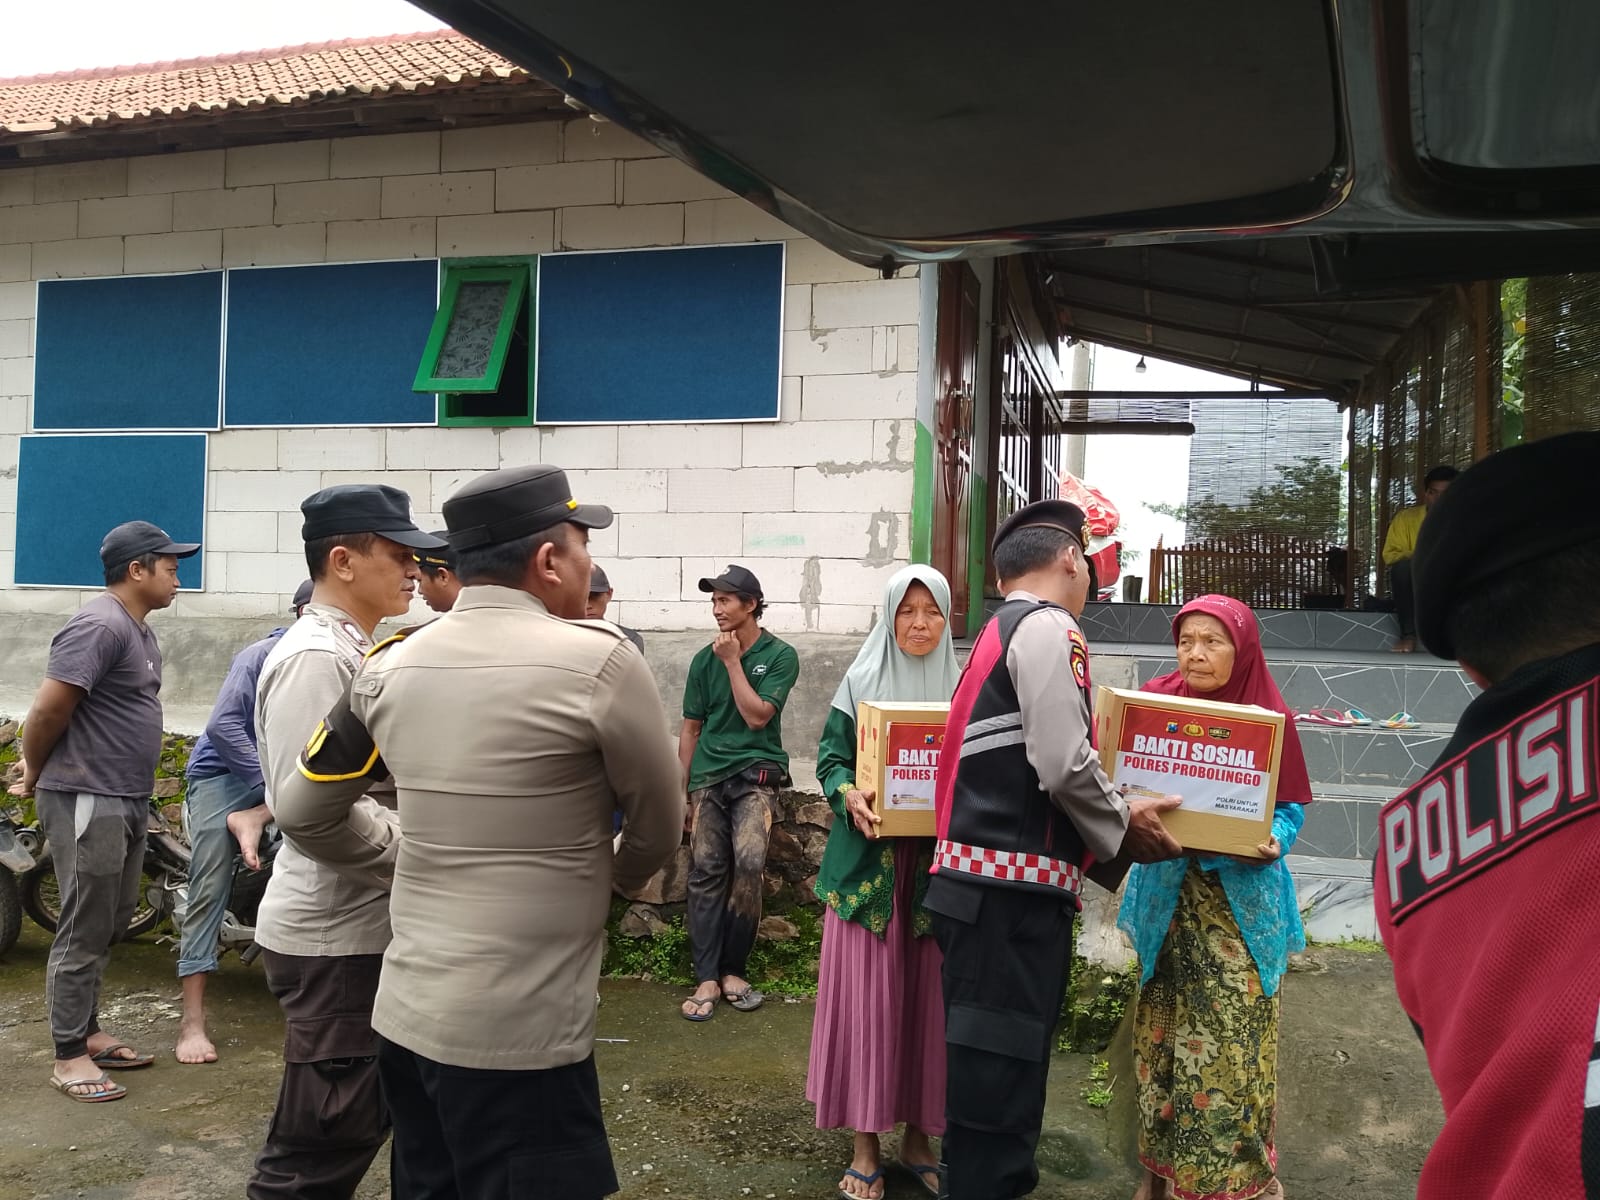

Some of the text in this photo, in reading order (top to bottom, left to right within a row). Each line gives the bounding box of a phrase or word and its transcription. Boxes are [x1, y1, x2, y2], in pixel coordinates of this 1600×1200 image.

[898, 749, 941, 766] BAKT
[1132, 734, 1256, 769] BAKTI SOSIAL
[892, 768, 931, 780] POLRES
[1123, 755, 1261, 787] POLRES PROBOLINGGO
[1214, 802, 1258, 814] MASYARAKAT
[1216, 796, 1258, 807] POLRI UNTUK
[1384, 692, 1587, 907] POLISI
